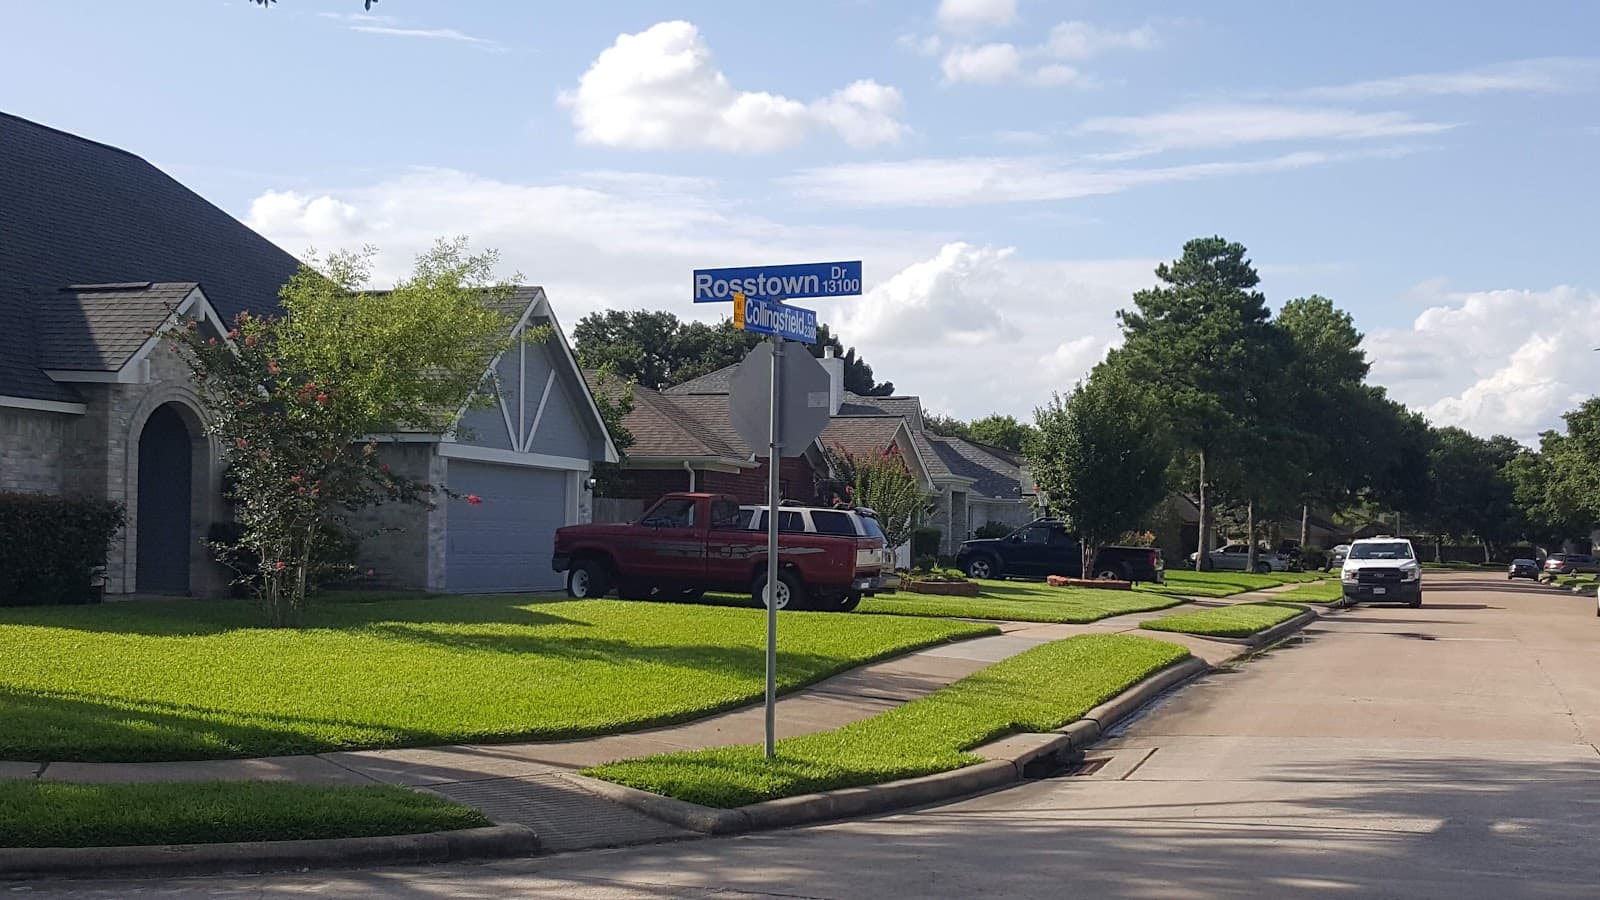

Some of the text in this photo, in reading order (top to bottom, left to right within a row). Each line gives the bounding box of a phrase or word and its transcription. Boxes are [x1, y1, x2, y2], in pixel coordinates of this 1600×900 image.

[695, 272, 860, 298] Rosstown 13100
[831, 266, 847, 280] Dr
[744, 298, 805, 335] Collingsfield
